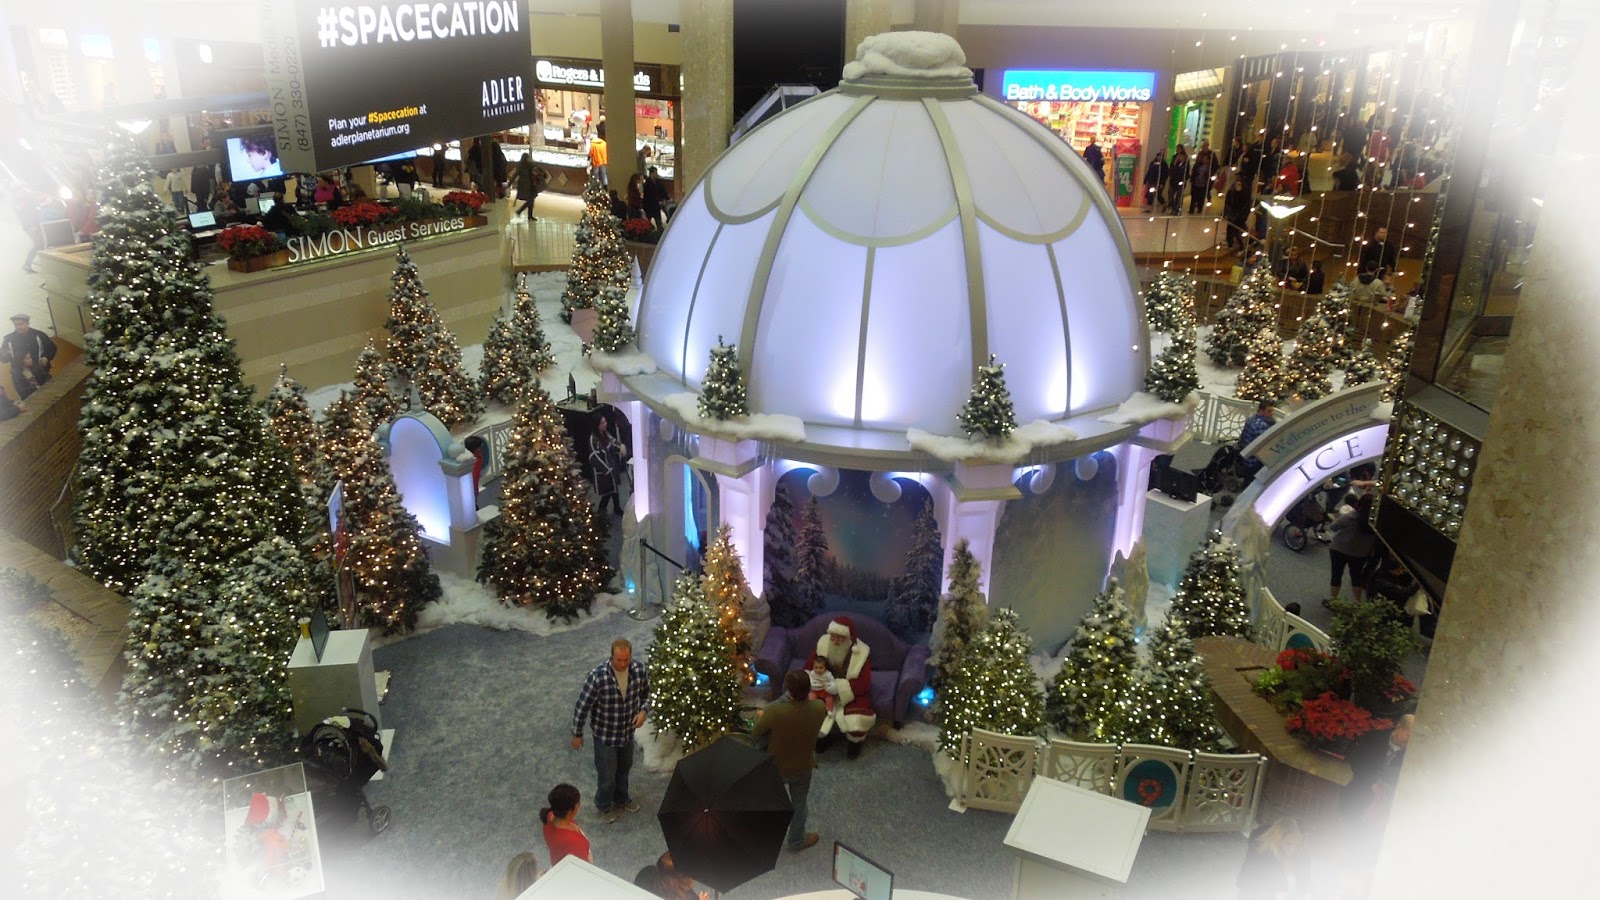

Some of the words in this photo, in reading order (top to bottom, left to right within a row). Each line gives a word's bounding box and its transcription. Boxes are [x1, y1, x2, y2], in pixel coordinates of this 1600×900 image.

[317, 0, 519, 47] #SPACECATION
[284, 35, 304, 109] 330-0220
[552, 65, 589, 84] Rogers
[590, 69, 599, 81] &
[482, 76, 524, 107] ADLER
[482, 103, 525, 118] PLANETARIUM
[1007, 84, 1045, 100] Bath
[1045, 84, 1058, 100] &
[1060, 84, 1100, 102] Body
[1101, 85, 1151, 100] Works
[272, 87, 292, 151] SIMON
[293, 114, 311, 152] (847)
[328, 118, 348, 131] Plan
[349, 117, 368, 130] your
[368, 107, 419, 124] #Spacecation
[419, 104, 428, 115] at
[330, 123, 410, 148] adlerplanetarium.org
[287, 226, 363, 263] SIMON
[367, 228, 406, 247] Guest
[410, 217, 465, 238] Services
[1270, 417, 1329, 455] Welcome
[1331, 412, 1344, 422] to
[1345, 403, 1367, 416] the
[1295, 435, 1363, 484] ICE
